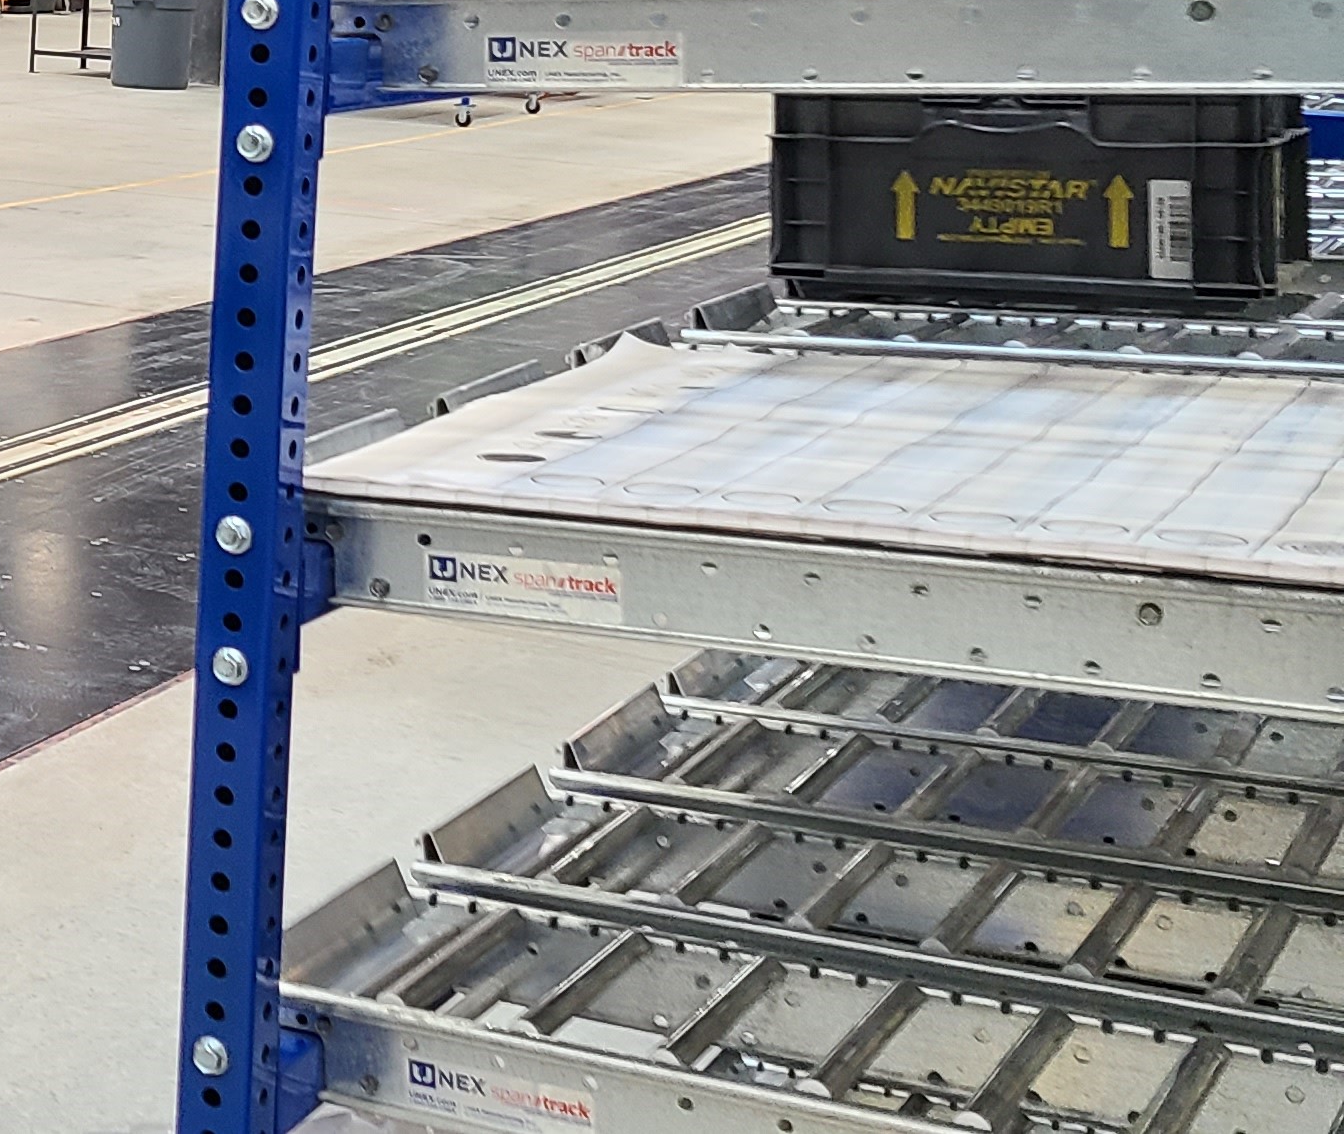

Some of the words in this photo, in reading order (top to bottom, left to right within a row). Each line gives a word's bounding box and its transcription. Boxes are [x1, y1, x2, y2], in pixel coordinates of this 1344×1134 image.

[487, 36, 569, 63] UNEX
[969, 215, 1055, 236] EMPTY
[428, 554, 510, 585] UNEX
[408, 1057, 487, 1098] UNEX
